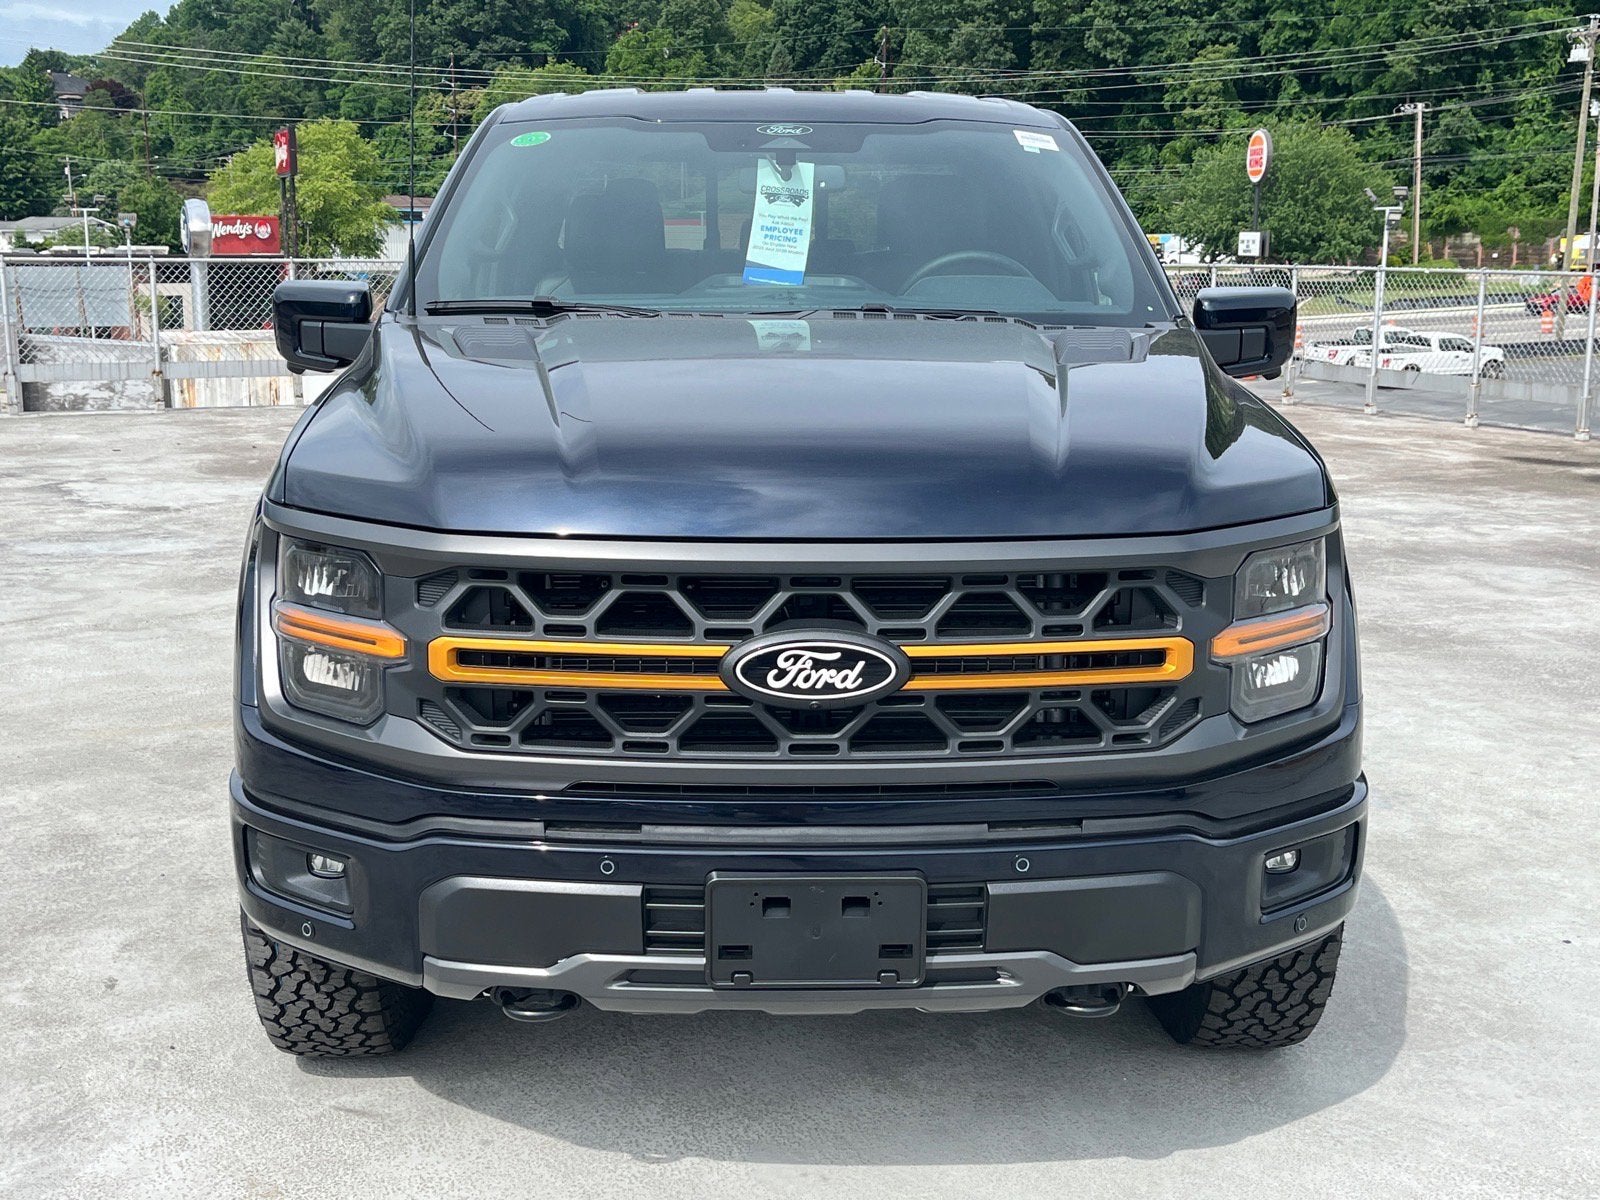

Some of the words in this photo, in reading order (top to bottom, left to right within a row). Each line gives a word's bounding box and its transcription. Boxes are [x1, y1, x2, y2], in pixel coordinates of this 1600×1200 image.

[766, 124, 804, 134] Ford
[1249, 156, 1263, 168] KING
[761, 185, 809, 196] CROSSROADS
[210, 219, 253, 239] Wendy's
[760, 225, 804, 236] EMPLOYEE
[764, 234, 797, 243] PRICING
[766, 649, 866, 690] Ford
